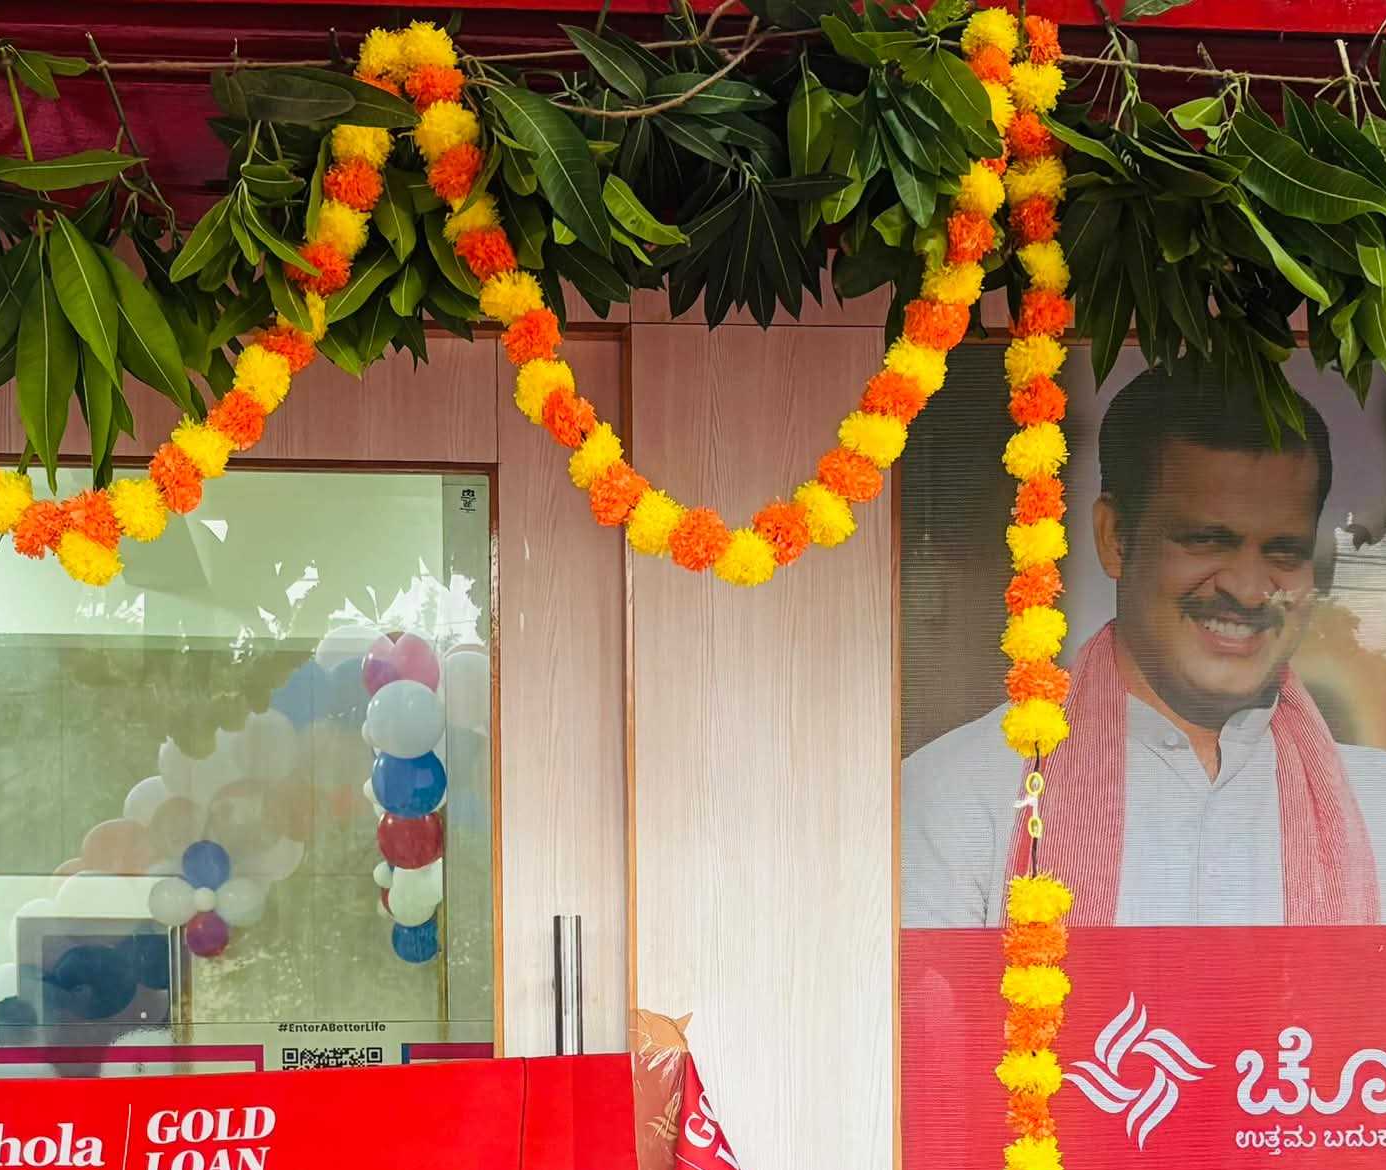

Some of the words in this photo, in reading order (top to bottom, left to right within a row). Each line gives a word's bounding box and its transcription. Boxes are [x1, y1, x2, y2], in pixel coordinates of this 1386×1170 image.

[278, 1022, 387, 1033] #EnterABetterLife
[146, 1105, 277, 1145] GOLD
[1235, 1124, 1316, 1155] ಉತ್ತಮ
